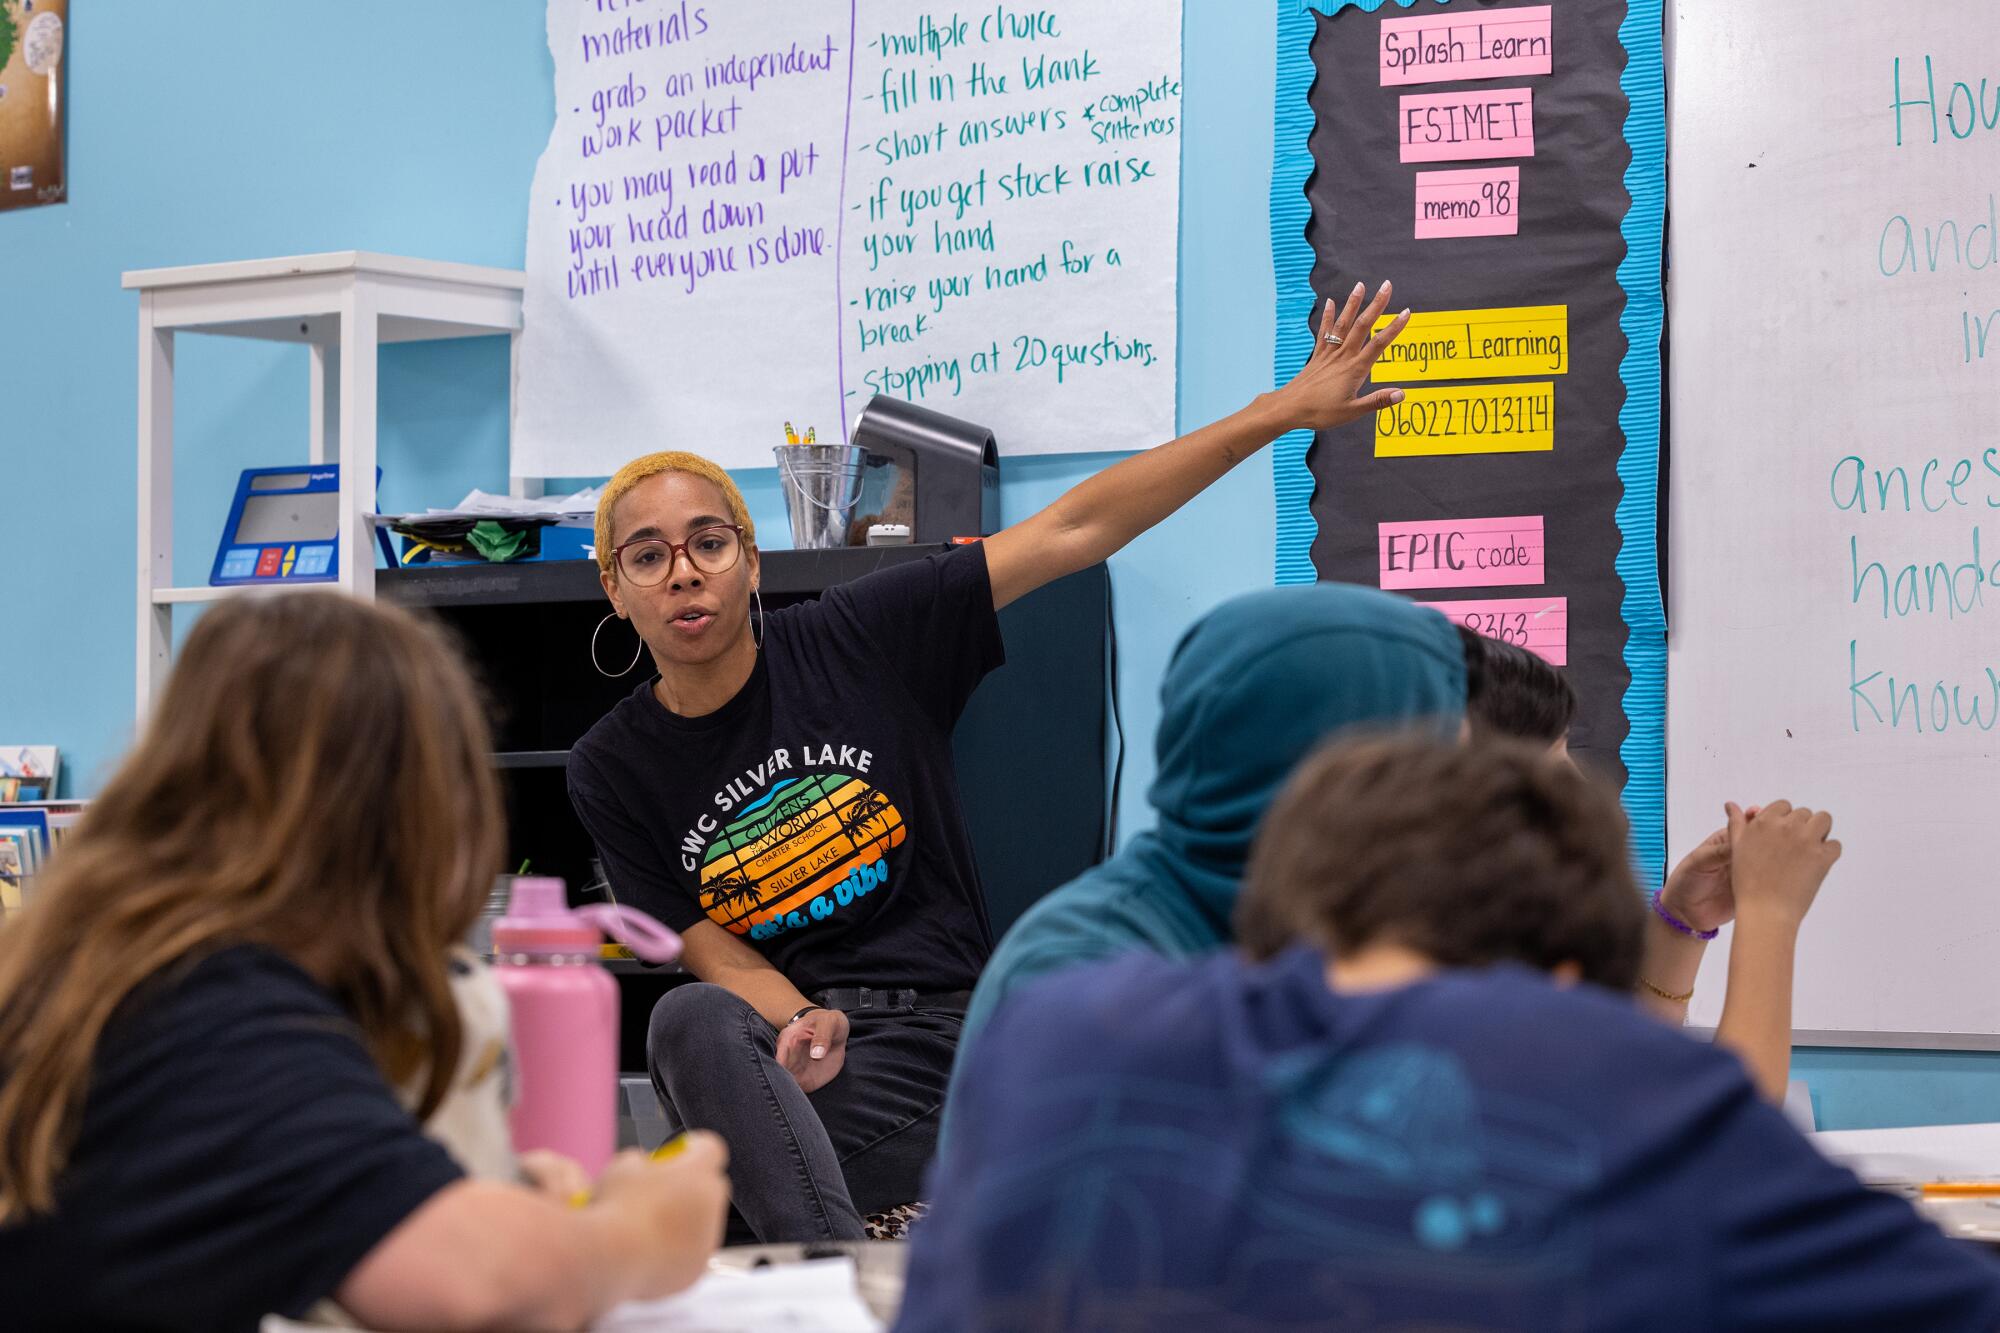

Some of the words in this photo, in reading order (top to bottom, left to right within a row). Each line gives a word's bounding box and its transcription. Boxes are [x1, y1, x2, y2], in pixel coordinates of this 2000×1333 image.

[582, 1, 708, 62] materials
[982, 5, 1061, 42] choice
[1385, 27, 1464, 75] Splash
[1479, 24, 1546, 60] Learn
[592, 72, 646, 127] grab
[666, 73, 693, 98] an
[704, 34, 839, 91] independent
[929, 66, 954, 101] in
[966, 61, 1007, 97] the
[1023, 50, 1101, 90] blank
[583, 118, 641, 157] work
[656, 95, 742, 151] packet
[959, 107, 1067, 148] answers
[1091, 115, 1176, 144] sentences
[1407, 102, 1523, 144] FSIMET
[571, 181, 613, 222] you
[624, 168, 672, 214] may
[689, 150, 736, 188] read
[781, 142, 819, 194] put
[900, 189, 942, 227] you
[949, 169, 986, 220] get
[998, 163, 1072, 200] stuck
[1084, 150, 1156, 187] raise
[570, 222, 614, 270] your
[629, 205, 687, 243] head
[703, 199, 763, 234] down
[864, 232, 918, 271] your
[935, 220, 994, 255] hand
[1879, 194, 1997, 277] and
[631, 246, 738, 294] everyone
[749, 233, 767, 269] is
[929, 272, 973, 313] your
[985, 254, 1046, 289] hand
[1061, 240, 1094, 274] for
[1106, 248, 1121, 266] a
[971, 342, 999, 373] at
[1013, 335, 1046, 371] 20
[1052, 331, 1157, 383] questions.
[1466, 323, 1561, 370] Learning
[1377, 395, 1548, 437] 060227013114
[1388, 532, 1465, 573] EPIC
[1476, 535, 1530, 569] code
[681, 813, 717, 872] CWC
[714, 748, 792, 812] SILVER
[803, 744, 873, 774] LAKE
[761, 808, 819, 846] WORLD
[756, 844, 791, 867] CHARTER
[792, 823, 827, 848] SCHOOL
[770, 867, 808, 893] SILVER
[810, 846, 840, 871] LAKE
[834, 859, 888, 907] vibe
